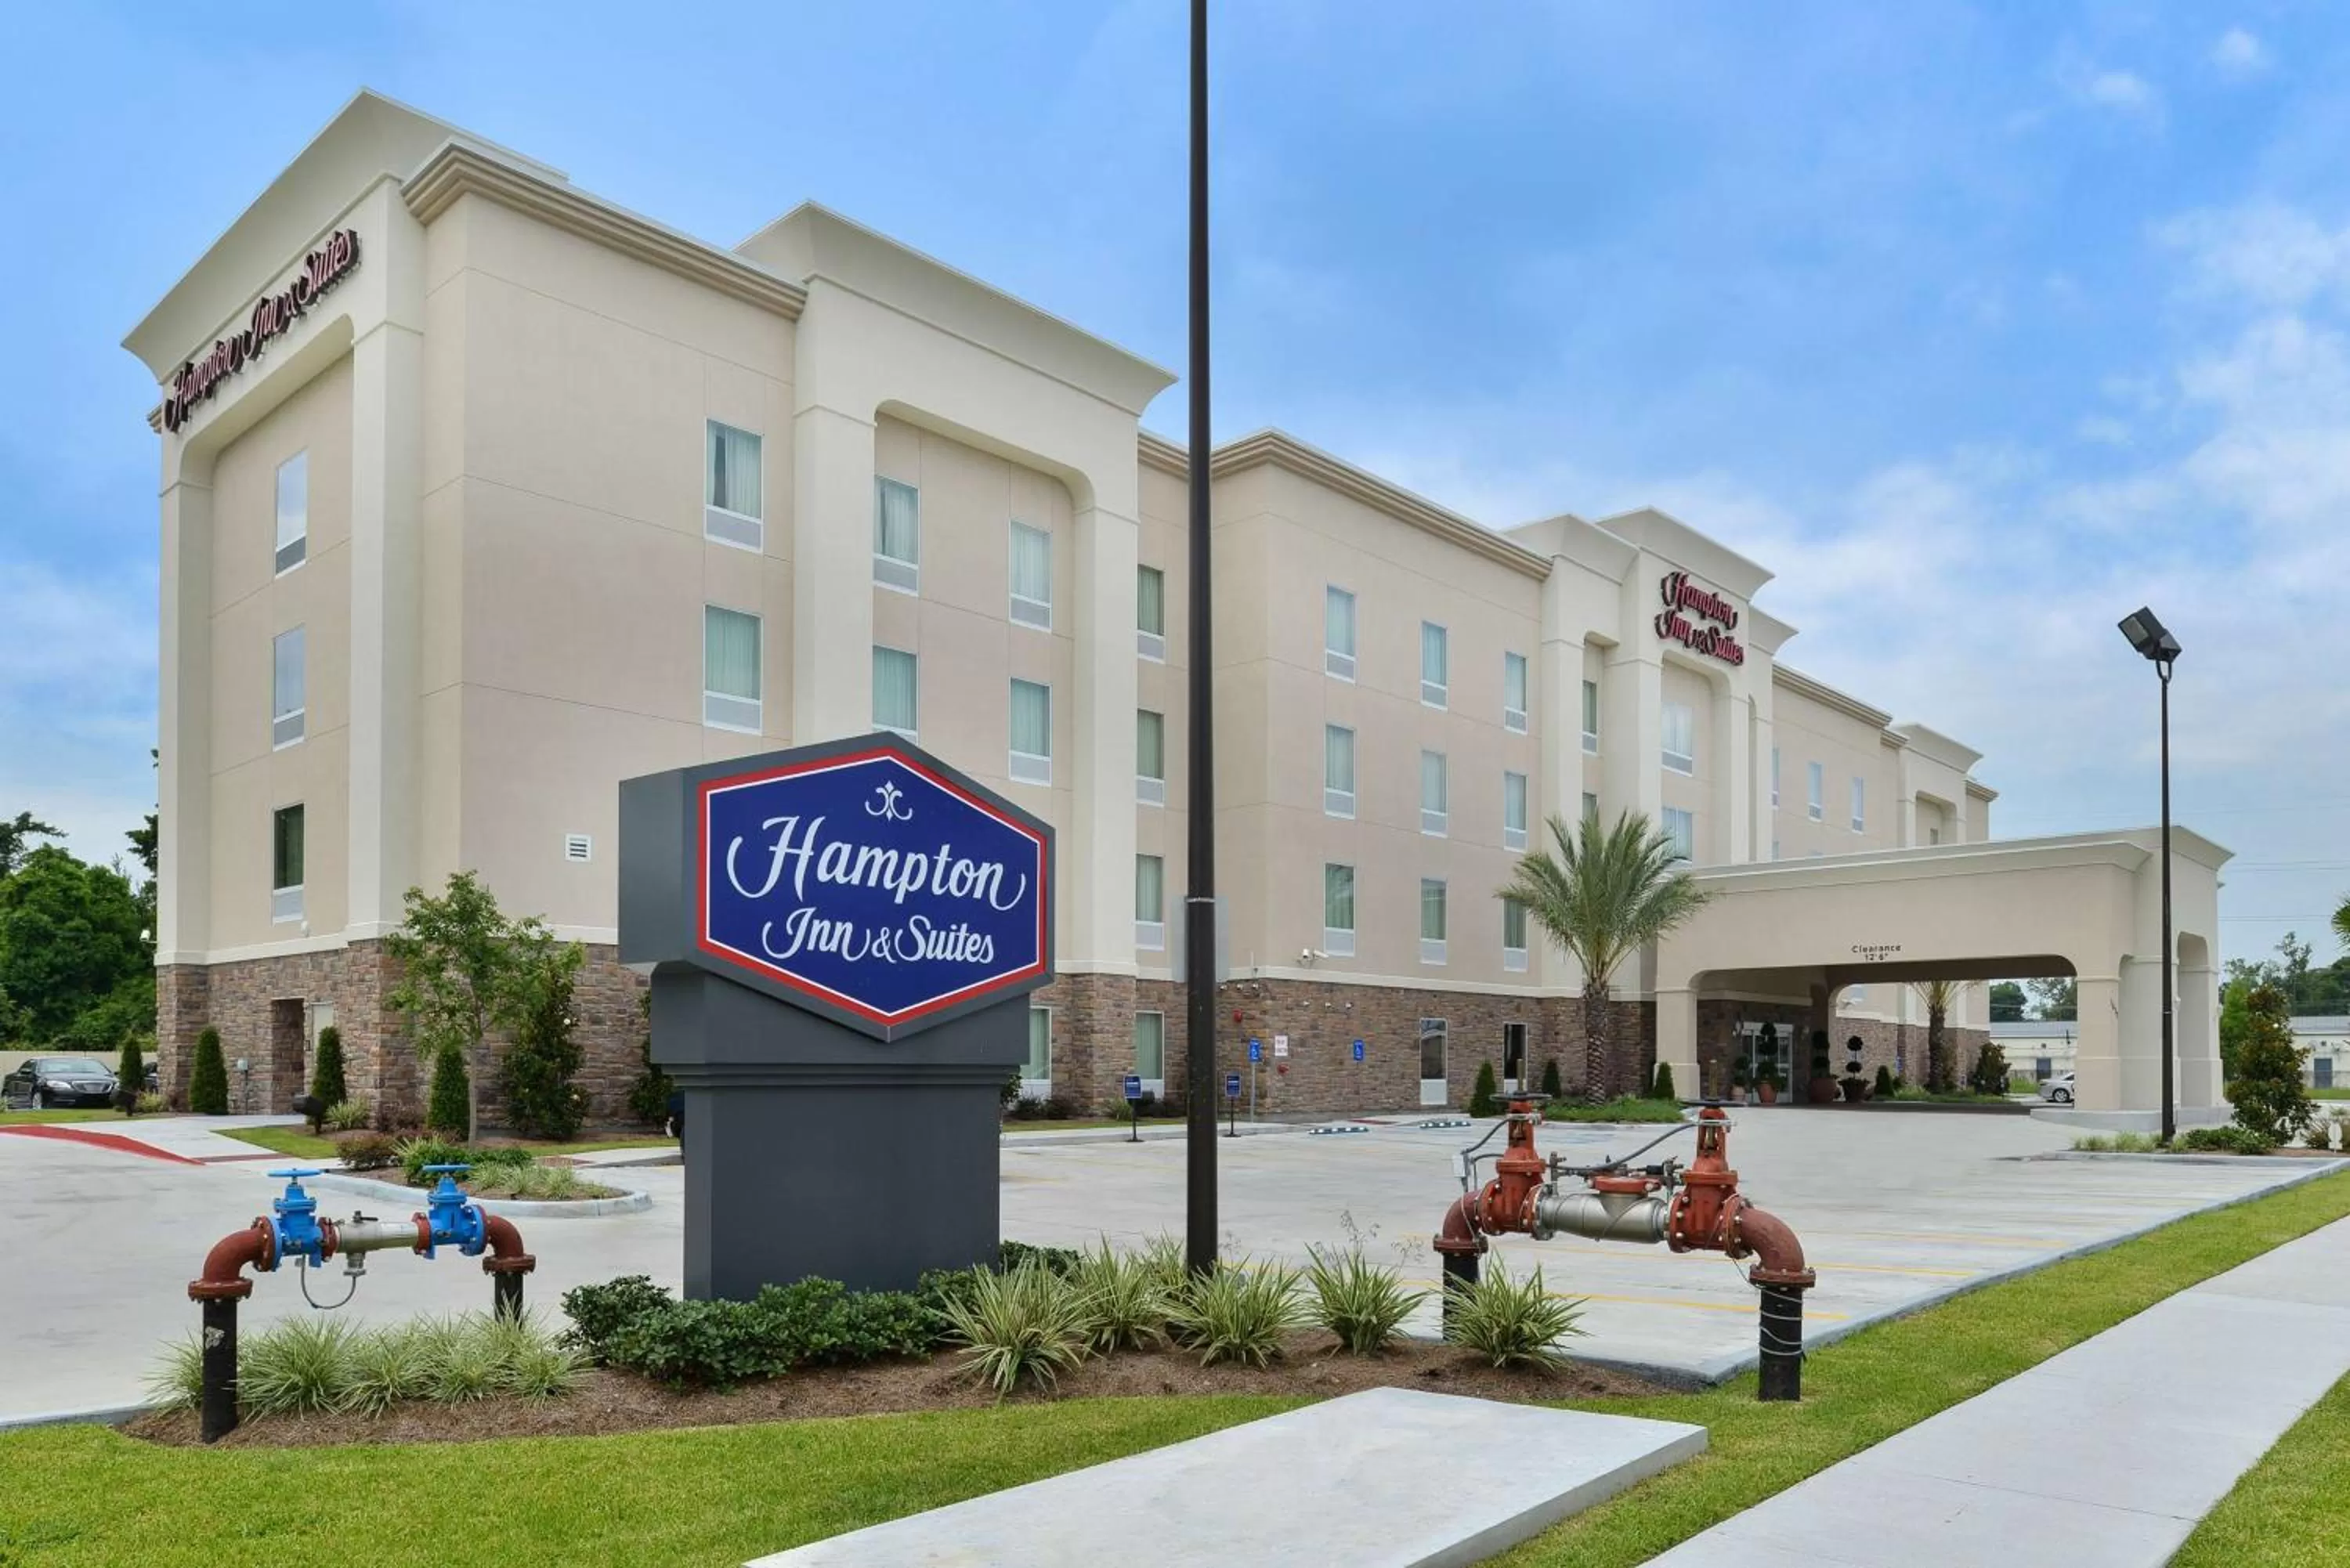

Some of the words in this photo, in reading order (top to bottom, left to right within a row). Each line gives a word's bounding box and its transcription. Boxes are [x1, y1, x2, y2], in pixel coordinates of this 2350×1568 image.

[163, 338, 244, 433] Hampton
[243, 295, 291, 361] Inn
[297, 228, 360, 306] Suites
[1661, 571, 1737, 630] Hampton
[1654, 610, 1697, 649] Inn
[1706, 626, 1744, 666] Suites
[727, 815, 1026, 911] Hampton
[762, 907, 870, 962] Inn
[871, 927, 897, 965] &
[895, 915, 994, 964] Suites
